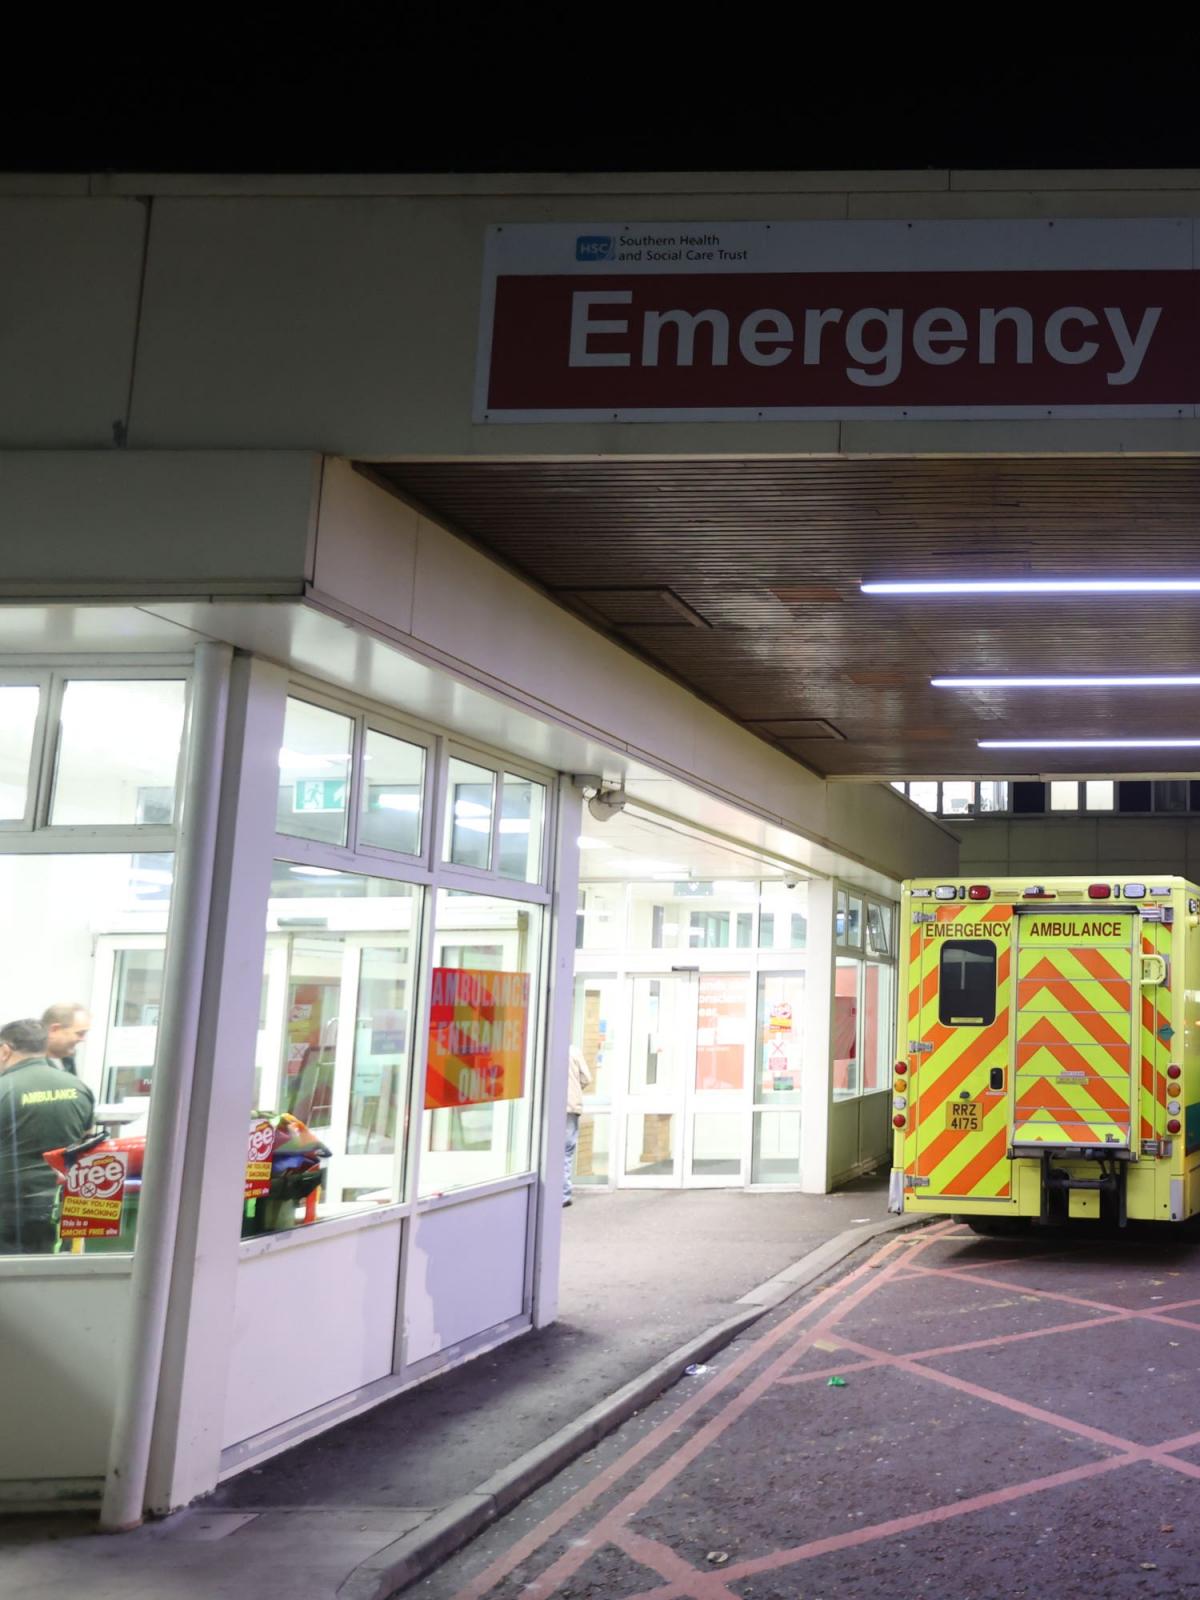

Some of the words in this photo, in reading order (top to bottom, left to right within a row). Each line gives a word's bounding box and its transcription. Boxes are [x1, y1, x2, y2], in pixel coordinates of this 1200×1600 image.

[619, 236, 675, 247] Southern
[680, 234, 720, 246] Health
[618, 251, 642, 261] and
[647, 250, 682, 261] Social
[686, 250, 714, 261] Care
[718, 250, 748, 260] Trust
[567, 289, 1163, 387] Emergency
[925, 922, 1011, 938] EMERGENCY
[1030, 922, 1121, 937] AMBULANCE
[431, 972, 531, 1008] AMBULANCE
[436, 1020, 521, 1056] ENTRANCE
[458, 1066, 498, 1103] ONLY
[22, 1088, 78, 1106] AMBULANCE
[952, 1103, 976, 1116] RRZ
[951, 1117, 978, 1130] 4175
[249, 1127, 273, 1150] ree
[67, 1161, 123, 1191] free
[64, 1206, 81, 1214] NOT
